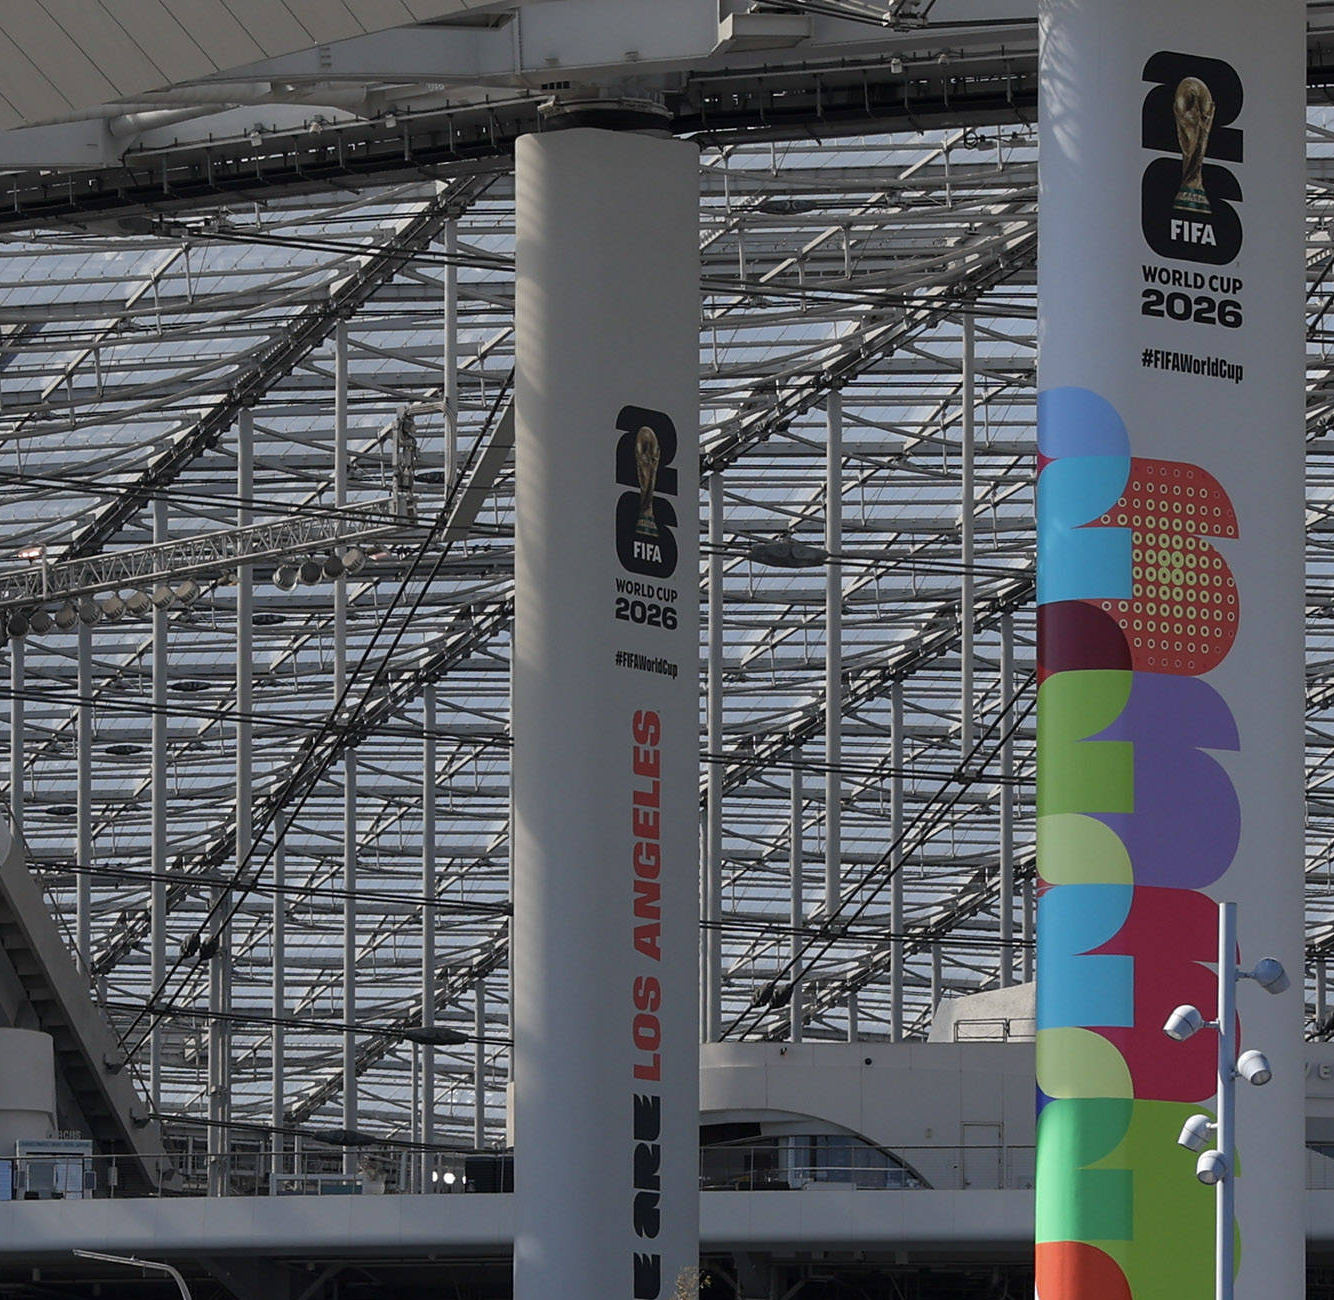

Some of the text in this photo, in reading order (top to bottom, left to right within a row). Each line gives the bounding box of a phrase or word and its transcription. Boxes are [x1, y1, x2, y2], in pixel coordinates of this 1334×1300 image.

[1170, 218, 1217, 247] FIFA
[1142, 264, 1243, 295] WORLD CUP
[1141, 288, 1243, 329] 2026
[1141, 348, 1244, 384] #FIFAWorldCup
[633, 540, 663, 564] FIFA
[616, 577, 678, 604] WORLD CUP
[615, 596, 678, 631] 2026
[615, 650, 678, 680] #FIFAWorldCup
[633, 711, 661, 961] ANGELES
[633, 976, 661, 1081] LOS
[633, 1094, 661, 1239] ARE
